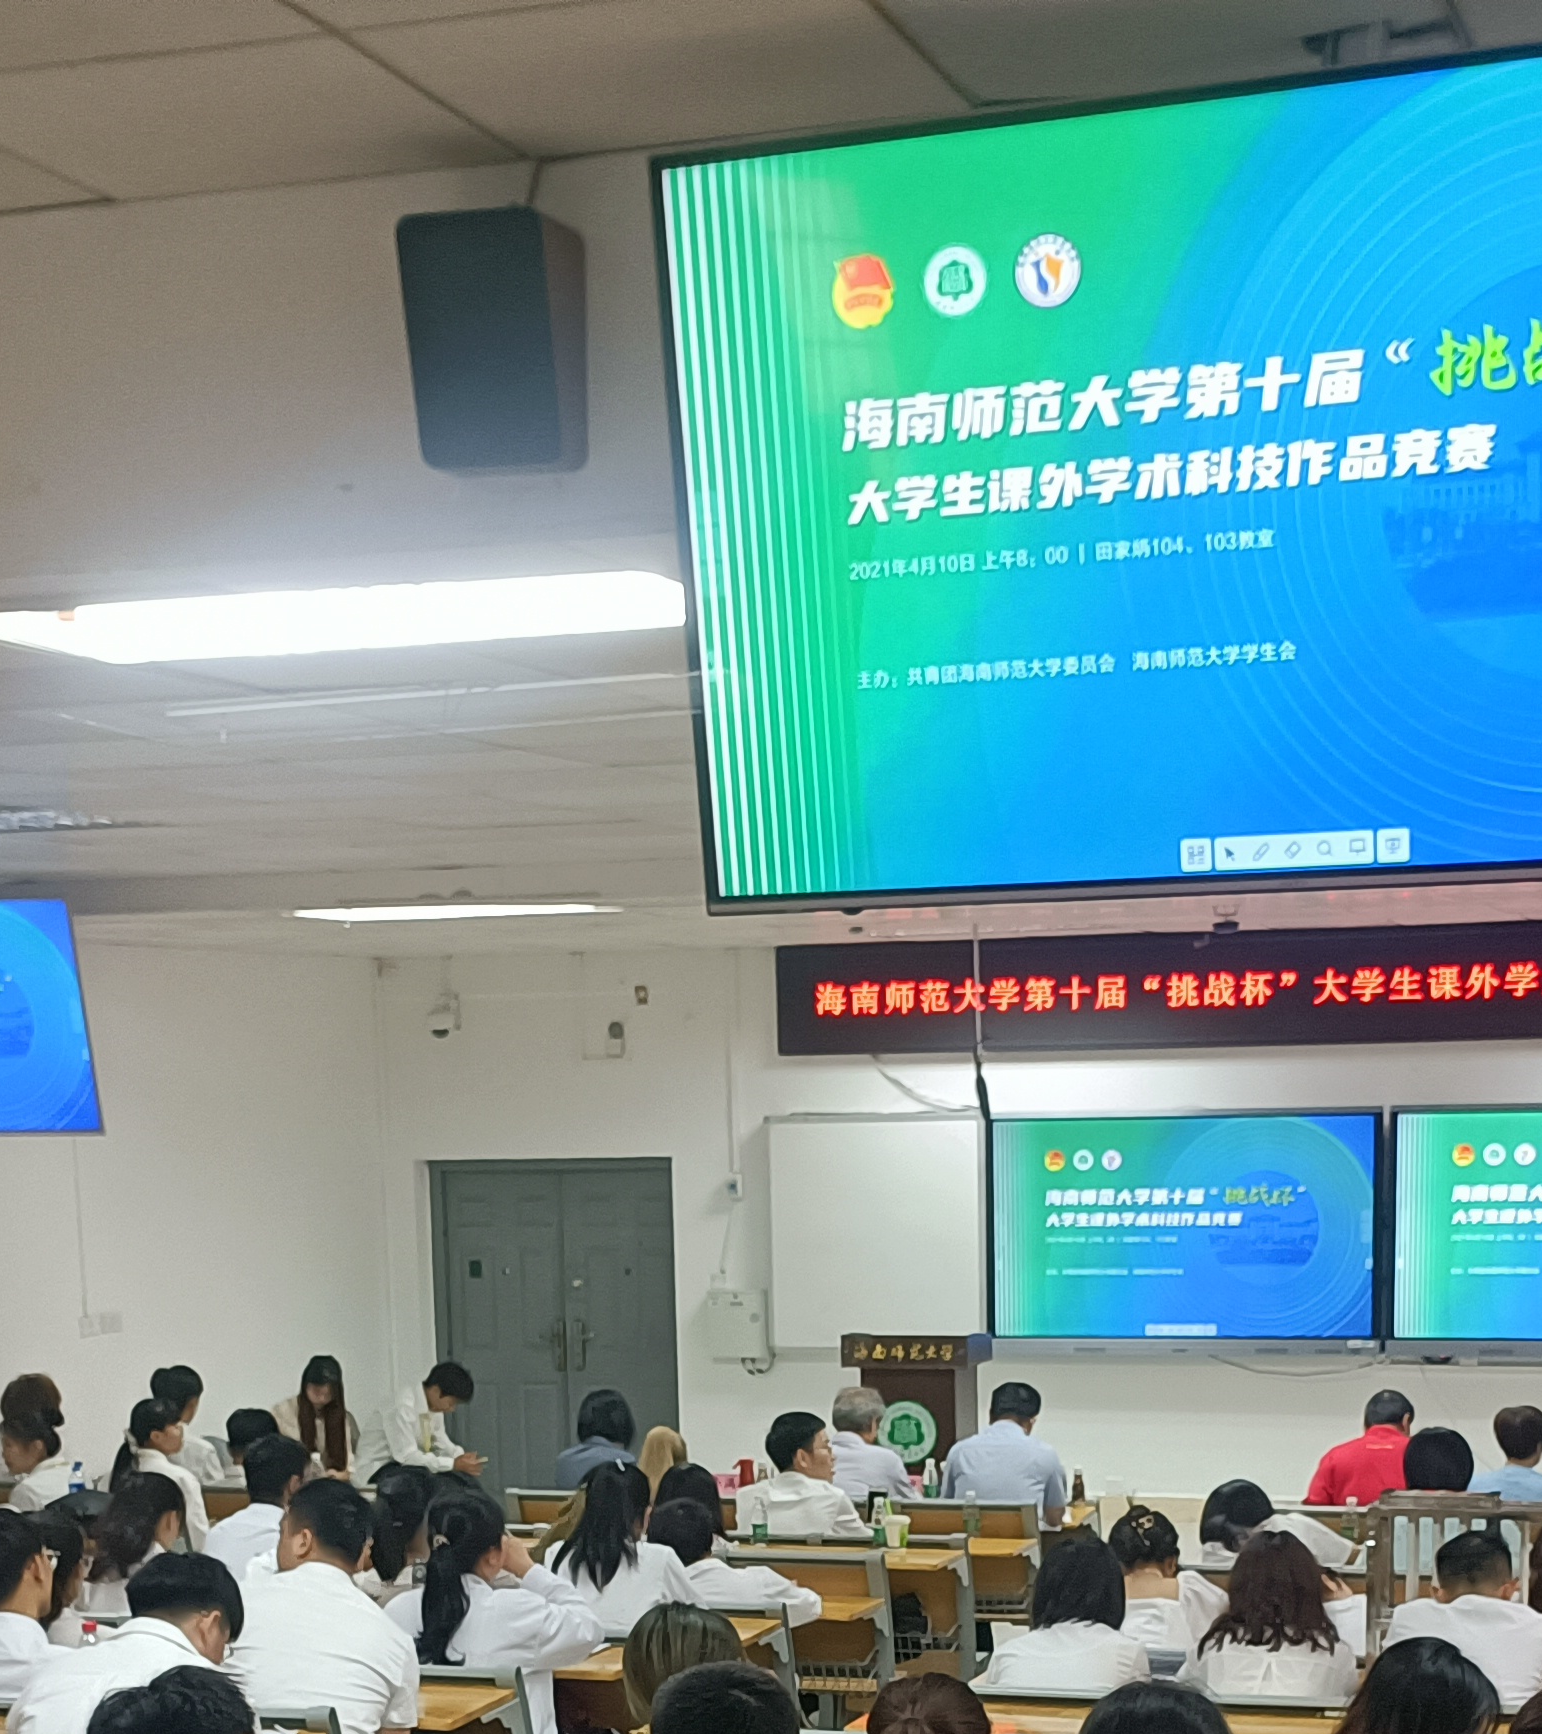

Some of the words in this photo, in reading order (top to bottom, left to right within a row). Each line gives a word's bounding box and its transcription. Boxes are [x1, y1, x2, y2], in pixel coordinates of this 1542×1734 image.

[847, 423, 1496, 527] 大学生课外学术科技作品竞赛
[849, 553, 975, 581] 2021年4月10日
